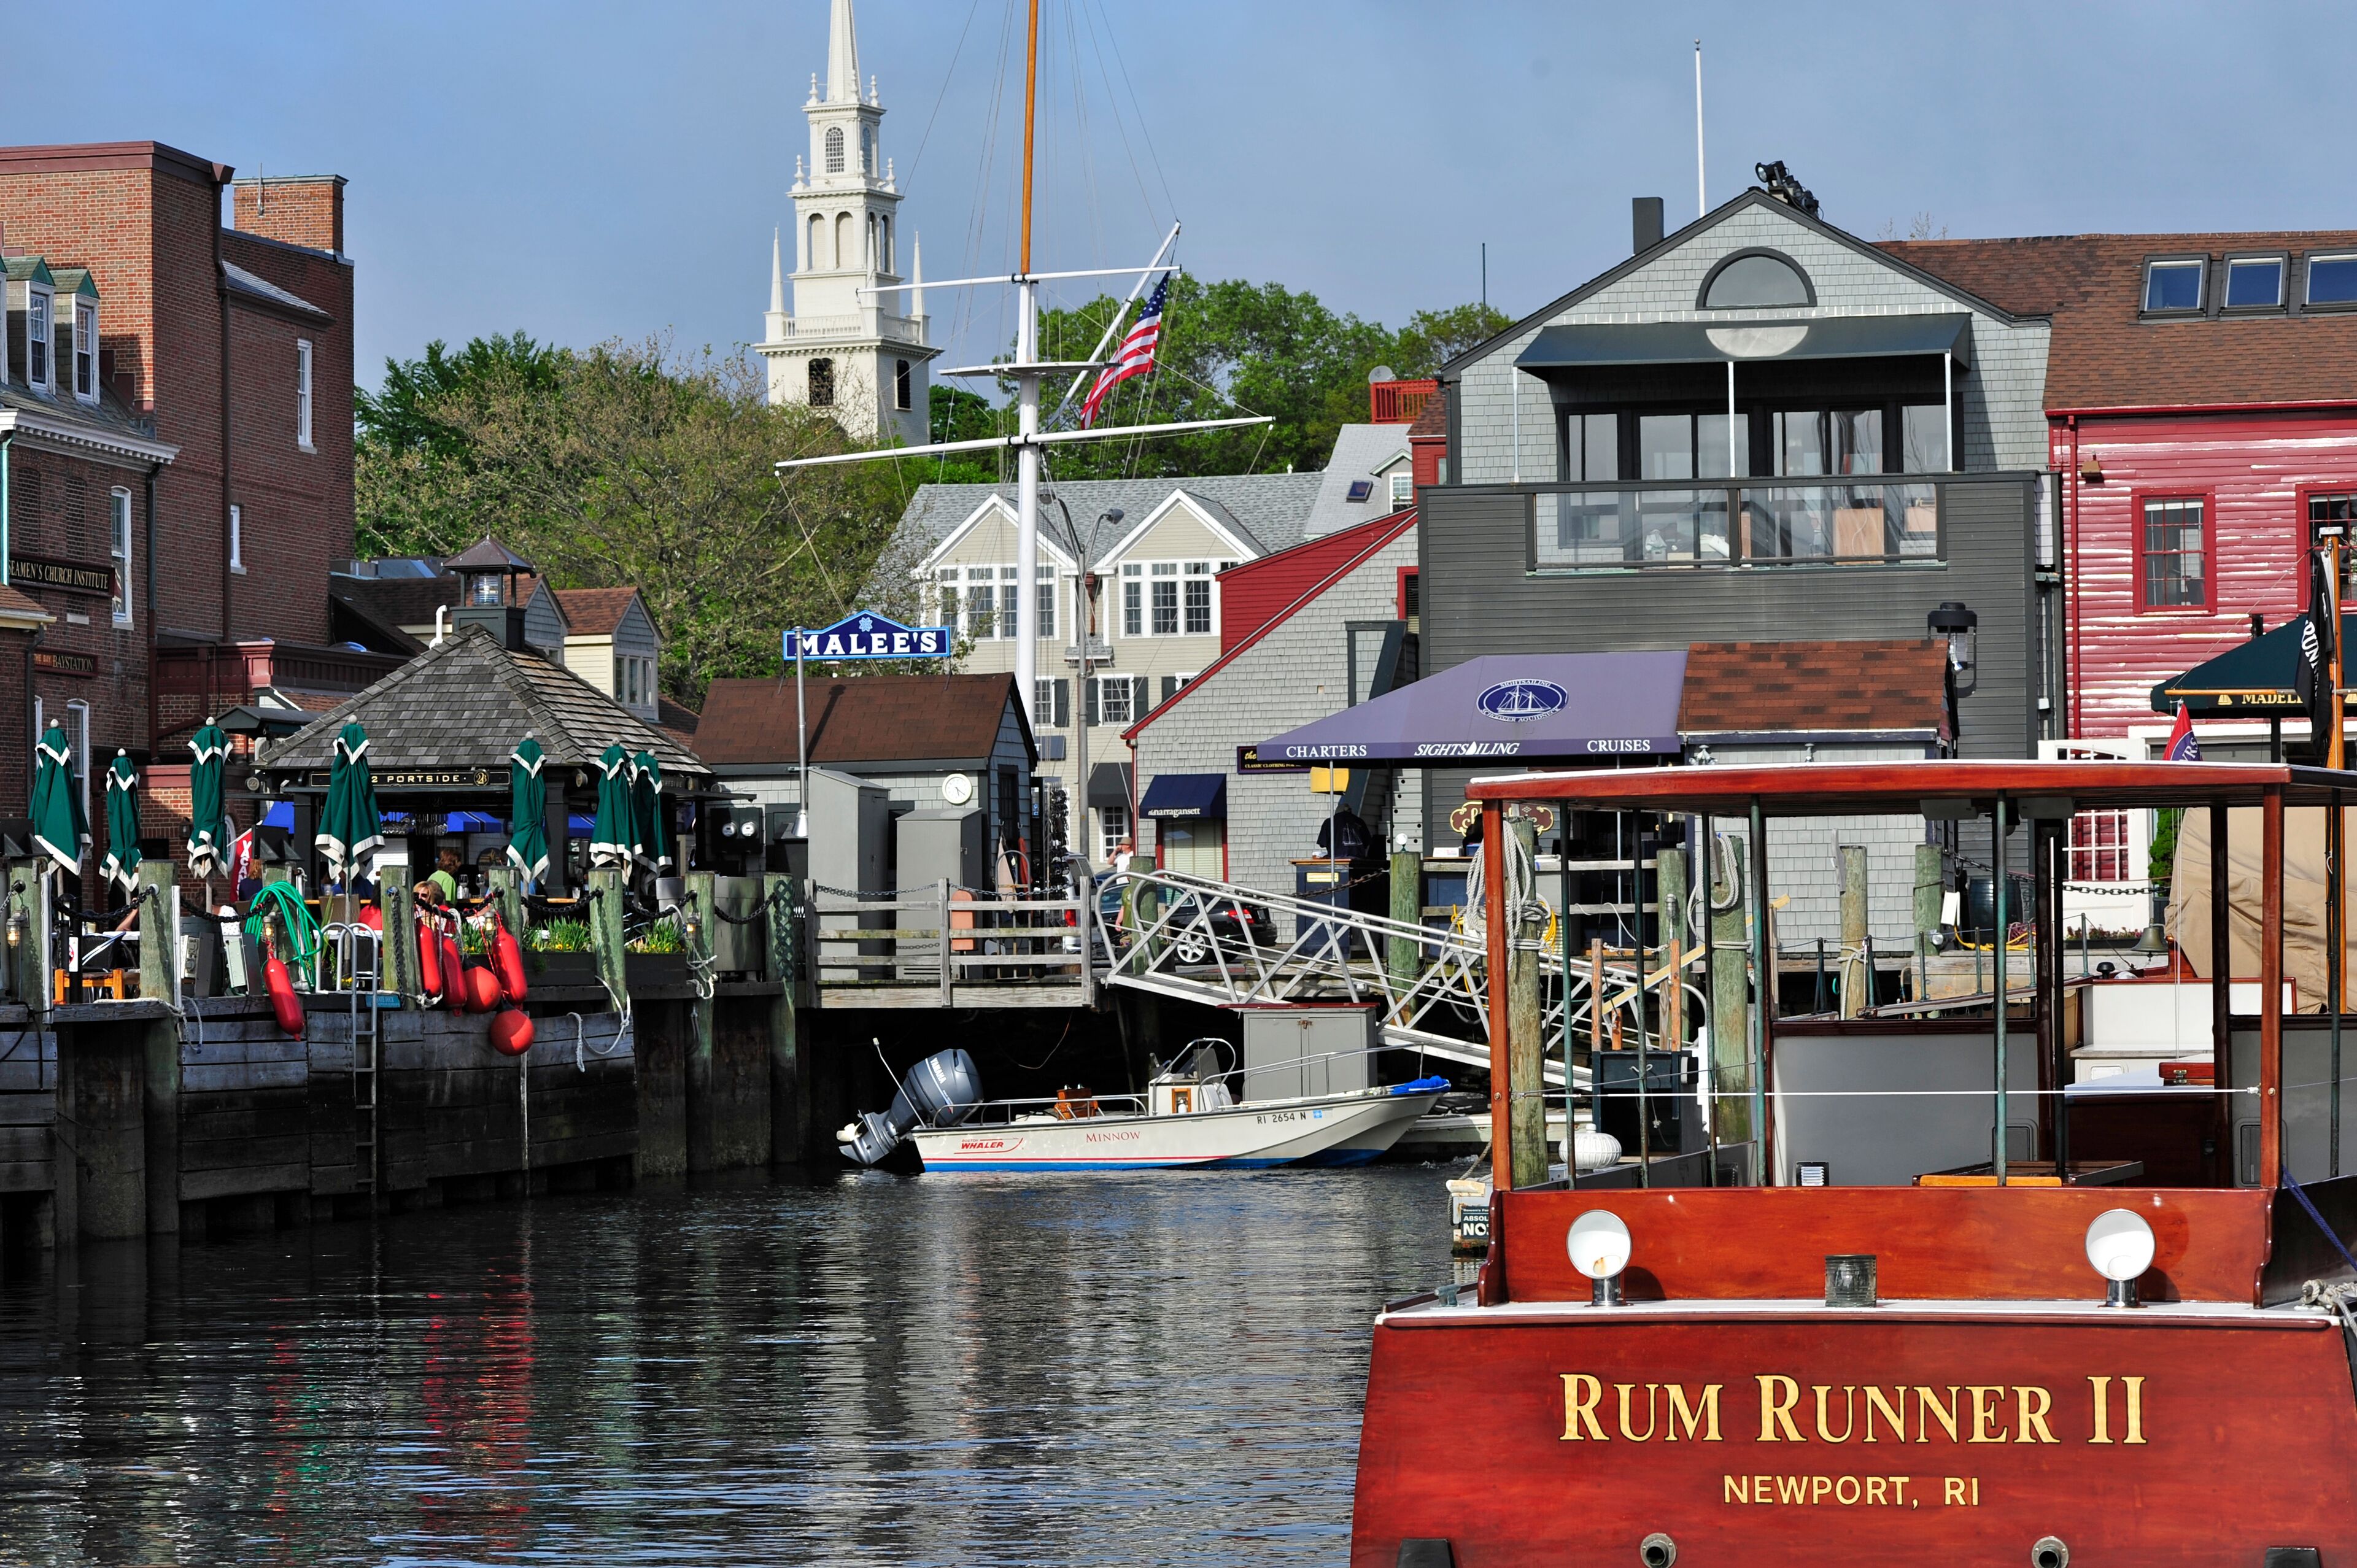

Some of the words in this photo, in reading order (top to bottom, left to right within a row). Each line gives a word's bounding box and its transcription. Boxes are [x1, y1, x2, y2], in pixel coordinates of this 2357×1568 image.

[9, 560, 43, 580] SEAMEN'S
[44, 565, 72, 584] CHURCH
[74, 570, 109, 589] INSTITUTE
[795, 631, 938, 655] MALEE'S
[53, 654, 94, 672] BAYSTATION
[1500, 679, 1552, 688] SIGHTSAILING
[1519, 706, 1561, 722] AQUIDNECK
[1286, 744, 1368, 758] CHARTERS
[1587, 739, 1651, 752] CRUISES
[1244, 751, 1257, 760] the
[387, 774, 460, 783] PORTSIDE
[930, 1057, 946, 1084] YAMAHA
[1256, 1115, 1266, 1124] RI
[1272, 1113, 1295, 1123] 2654
[1299, 1111, 1306, 1120] N
[1086, 1130, 1140, 1143] MINNOW
[1559, 1373, 1724, 1442] RUM
[1754, 1374, 2061, 1445] RUNNER
[2086, 1375, 2148, 1445] II
[1723, 1474, 1919, 1510] NEWPORT,
[1943, 1477, 1980, 1507] RI
